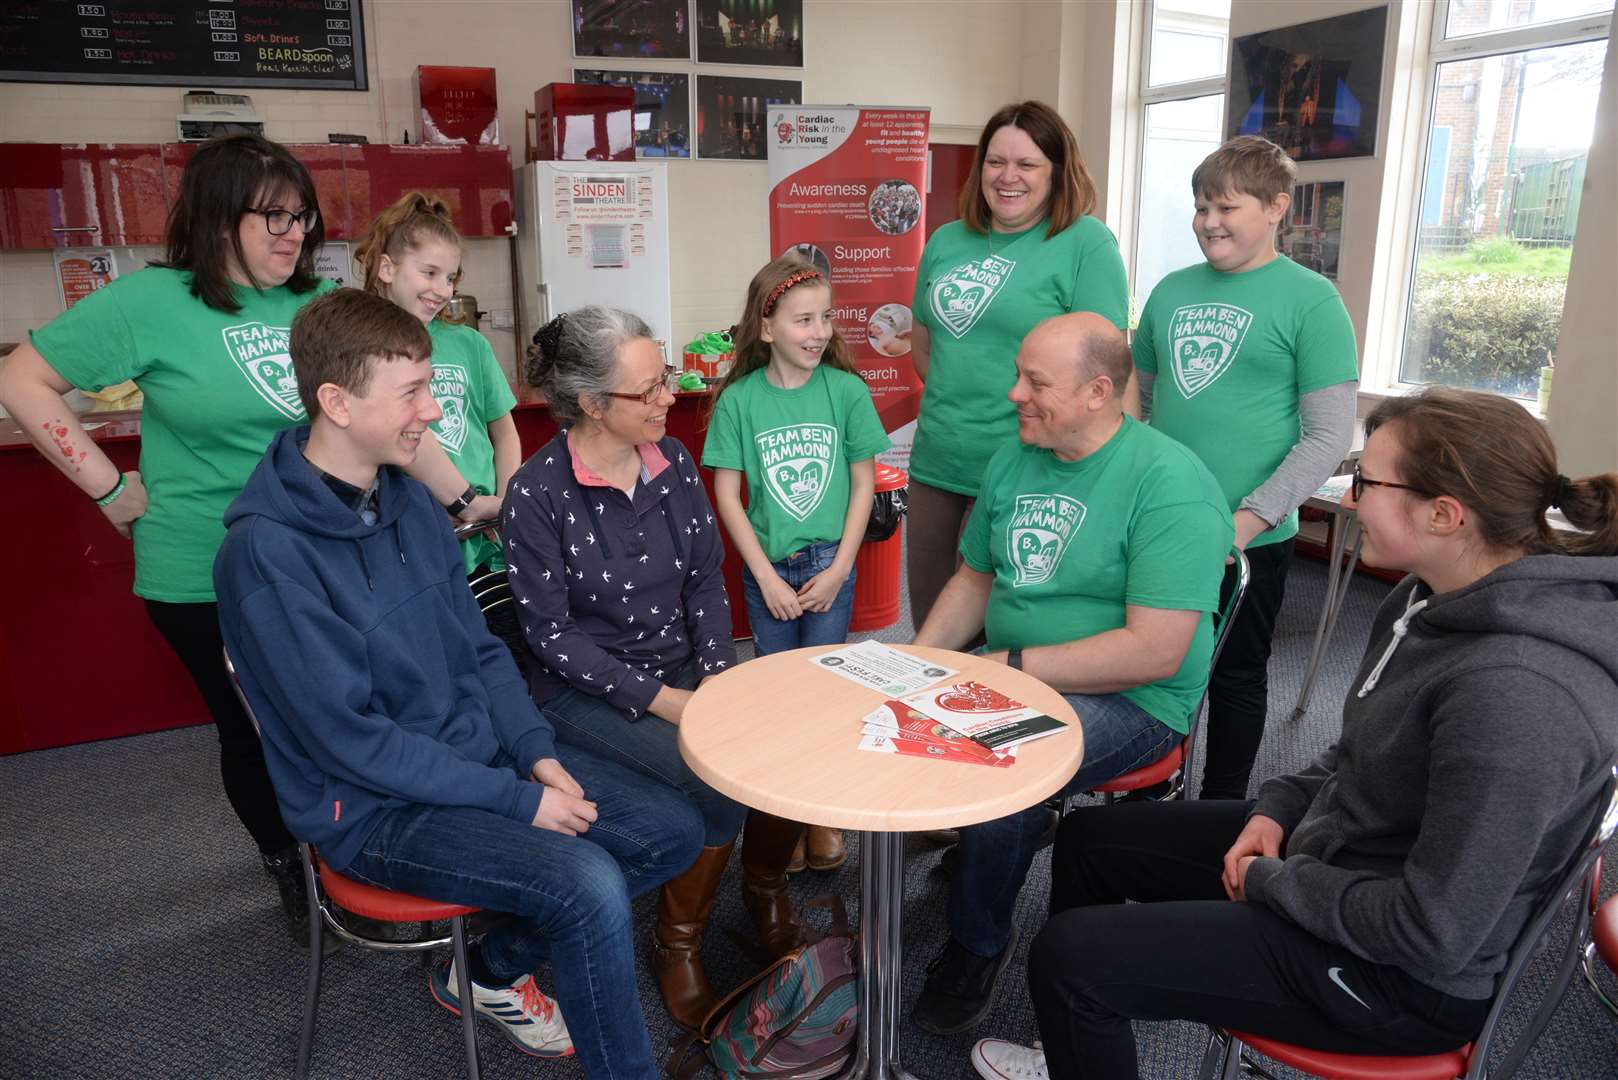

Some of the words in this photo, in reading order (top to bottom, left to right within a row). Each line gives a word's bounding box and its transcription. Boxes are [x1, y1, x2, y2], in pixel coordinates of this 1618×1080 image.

[243, 33, 268, 43] Soft
[798, 115, 835, 124] Cardiac
[798, 124, 820, 133] Risk
[821, 126, 830, 134] in
[831, 125, 846, 134] the
[798, 135, 829, 145] Young
[573, 184, 625, 197] SINDEN
[789, 182, 867, 197] Awareness
[834, 245, 891, 261] Support
[91, 260, 110, 272] 21
[317, 264, 338, 272] drinks
[982, 258, 1010, 276] BEN
[90, 279, 106, 290] 18
[829, 305, 868, 322] ening
[1178, 306, 1218, 322] TEAM
[1218, 308, 1247, 330] BEN
[1174, 320, 1238, 343] HAMMOND
[236, 338, 290, 362] HAMM
[433, 368, 465, 382] BEN
[859, 366, 898, 380] earch
[429, 382, 465, 397] MOND
[757, 429, 800, 451] TEAM
[800, 428, 832, 445] BEN
[761, 442, 831, 468] HAMMOND
